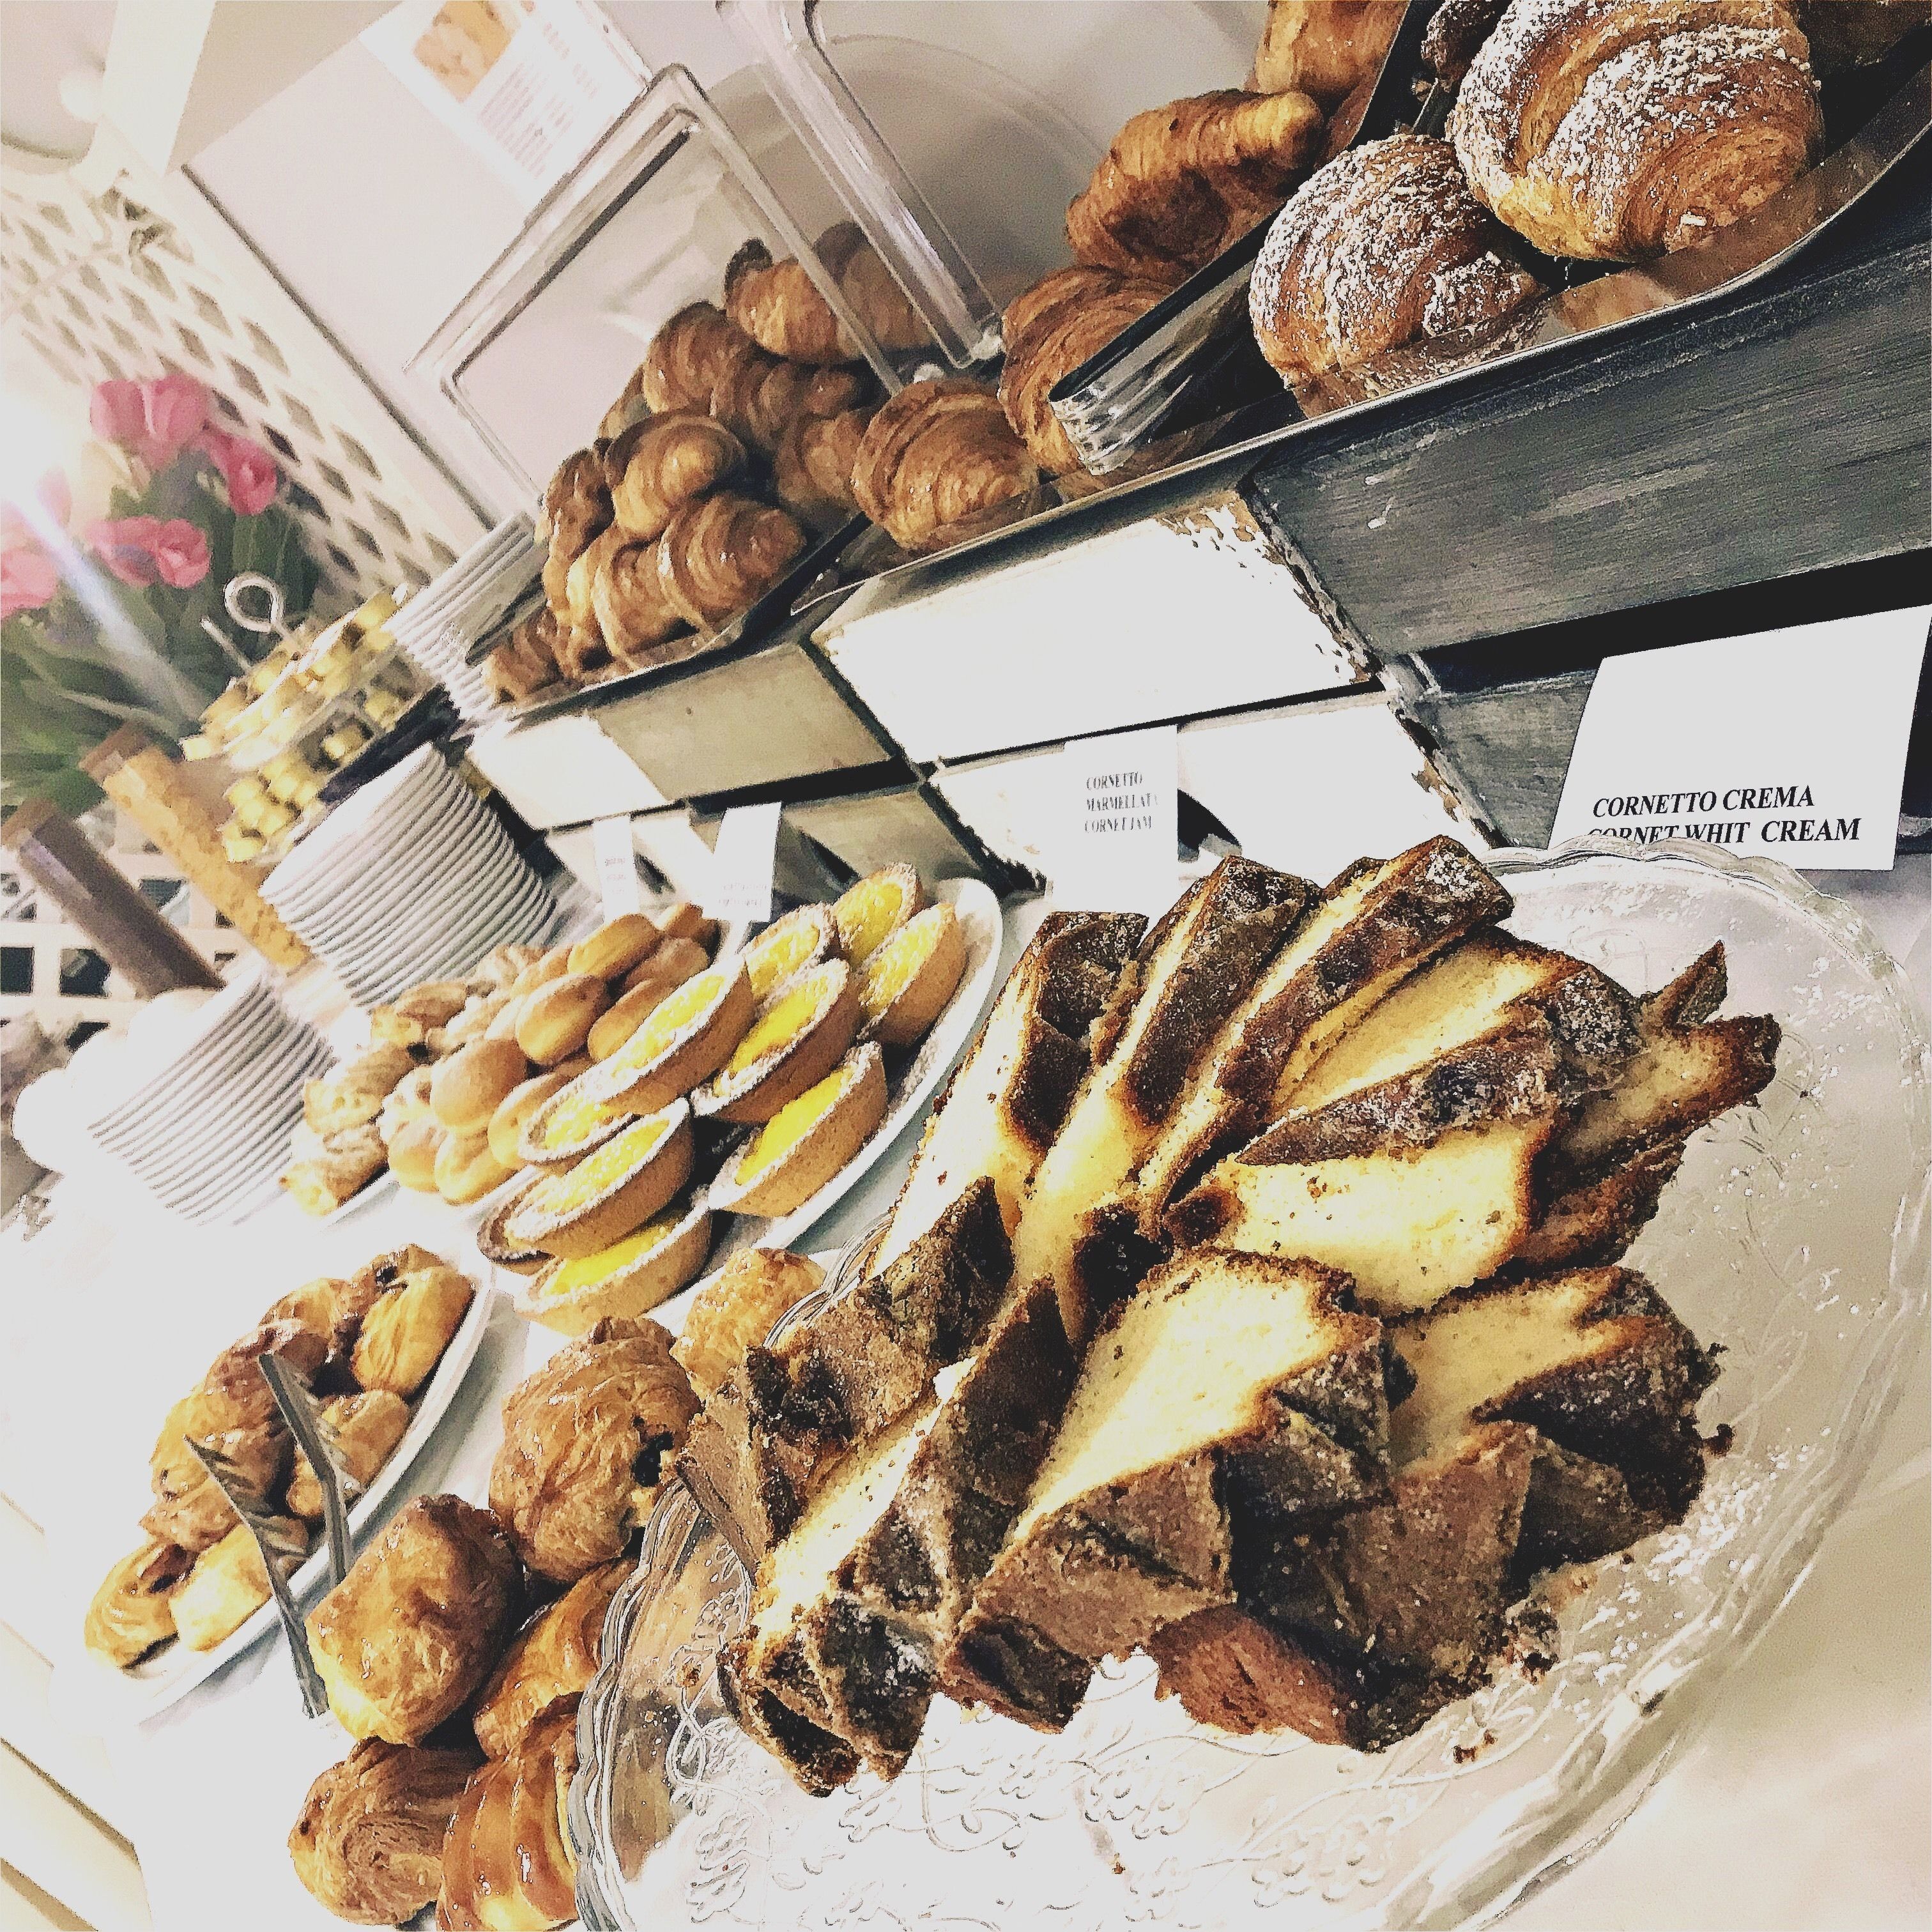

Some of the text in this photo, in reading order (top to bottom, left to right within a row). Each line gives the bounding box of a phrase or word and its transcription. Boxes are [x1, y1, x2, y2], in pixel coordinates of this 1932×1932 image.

[1086, 772, 1142, 790] CORNETTO
[1593, 785, 1815, 818] CORNETTO CREMA
[1085, 817, 1127, 833] CORNET
[1685, 822, 1751, 844] WHIT
[1761, 818, 1862, 843] CREAM
